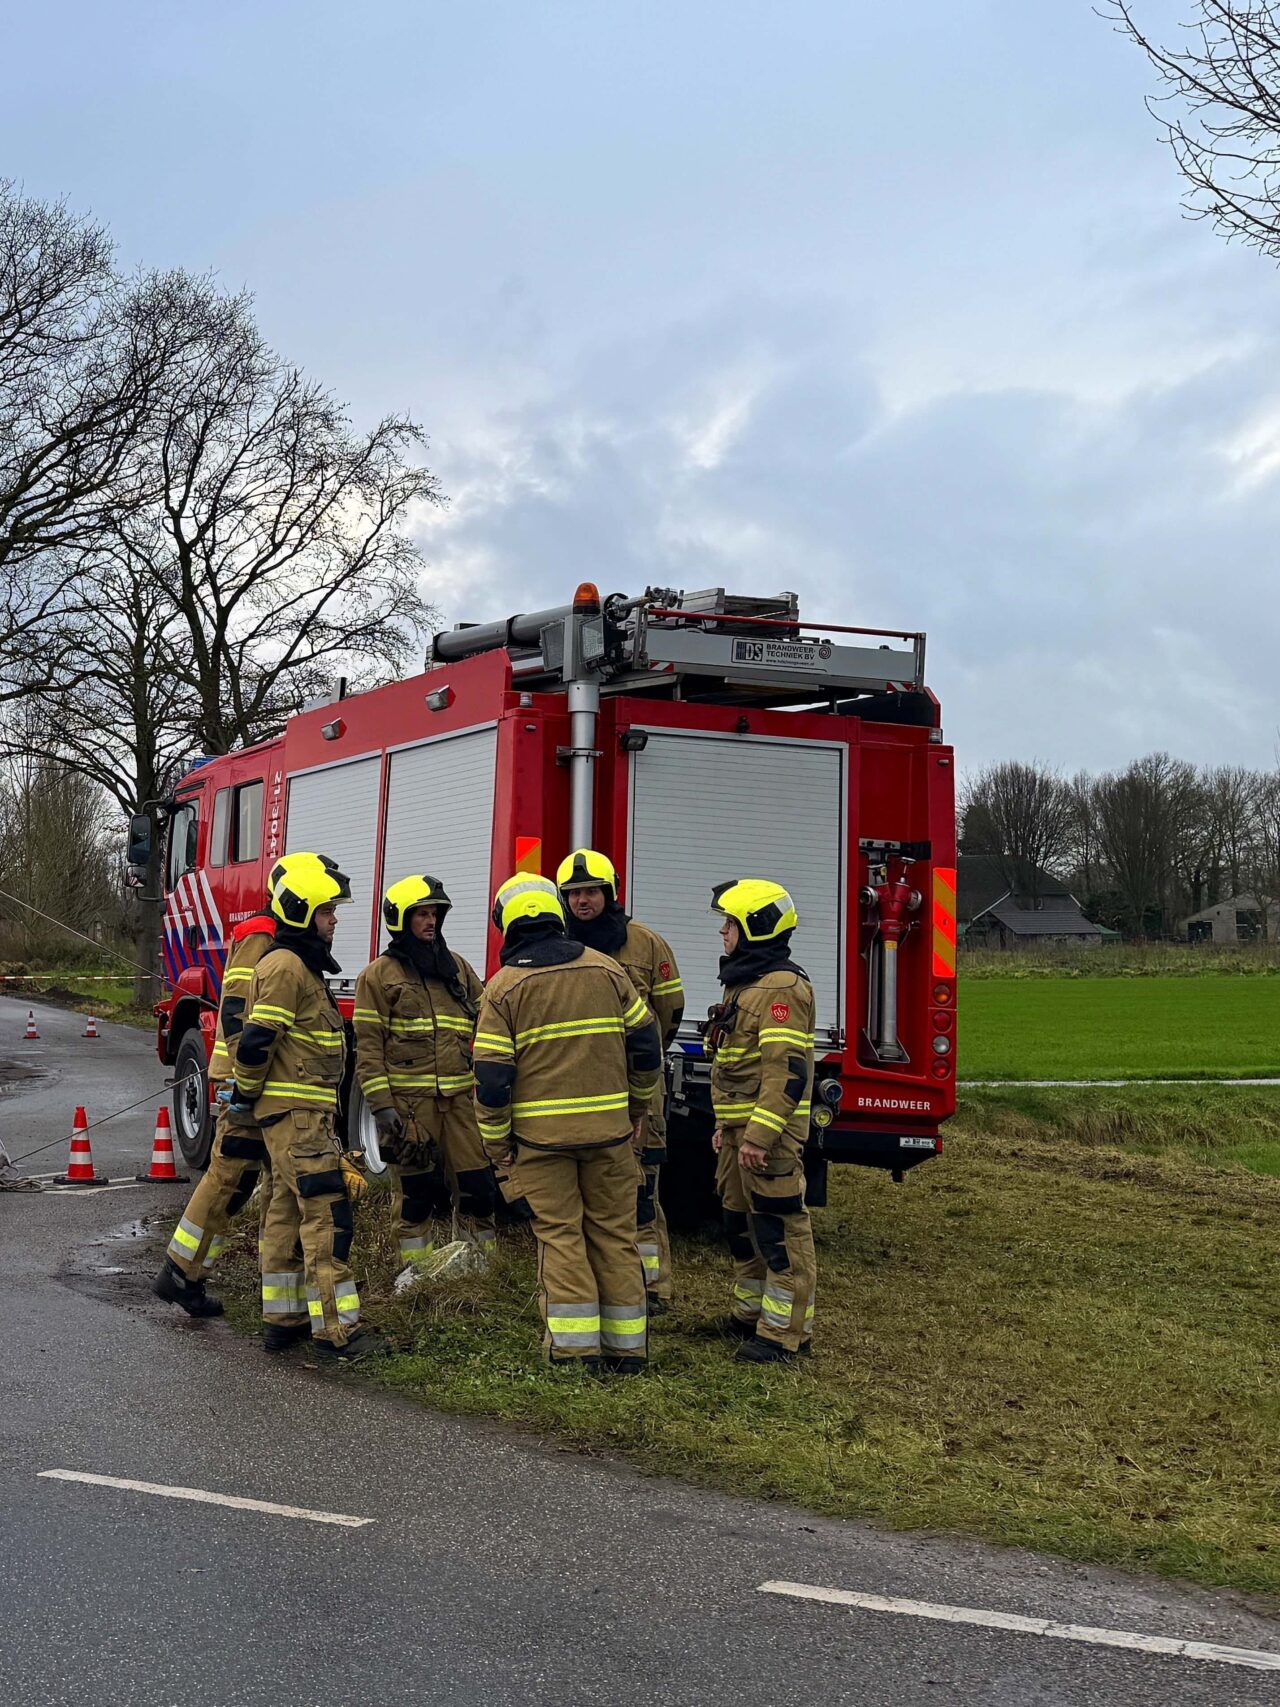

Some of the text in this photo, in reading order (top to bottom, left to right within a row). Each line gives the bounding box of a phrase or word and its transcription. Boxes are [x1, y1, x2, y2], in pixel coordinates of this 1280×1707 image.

[767, 650, 803, 659] TECHNIEK
[269, 770, 283, 859] 21-3041
[858, 1097, 931, 1110] BRANDWEER
